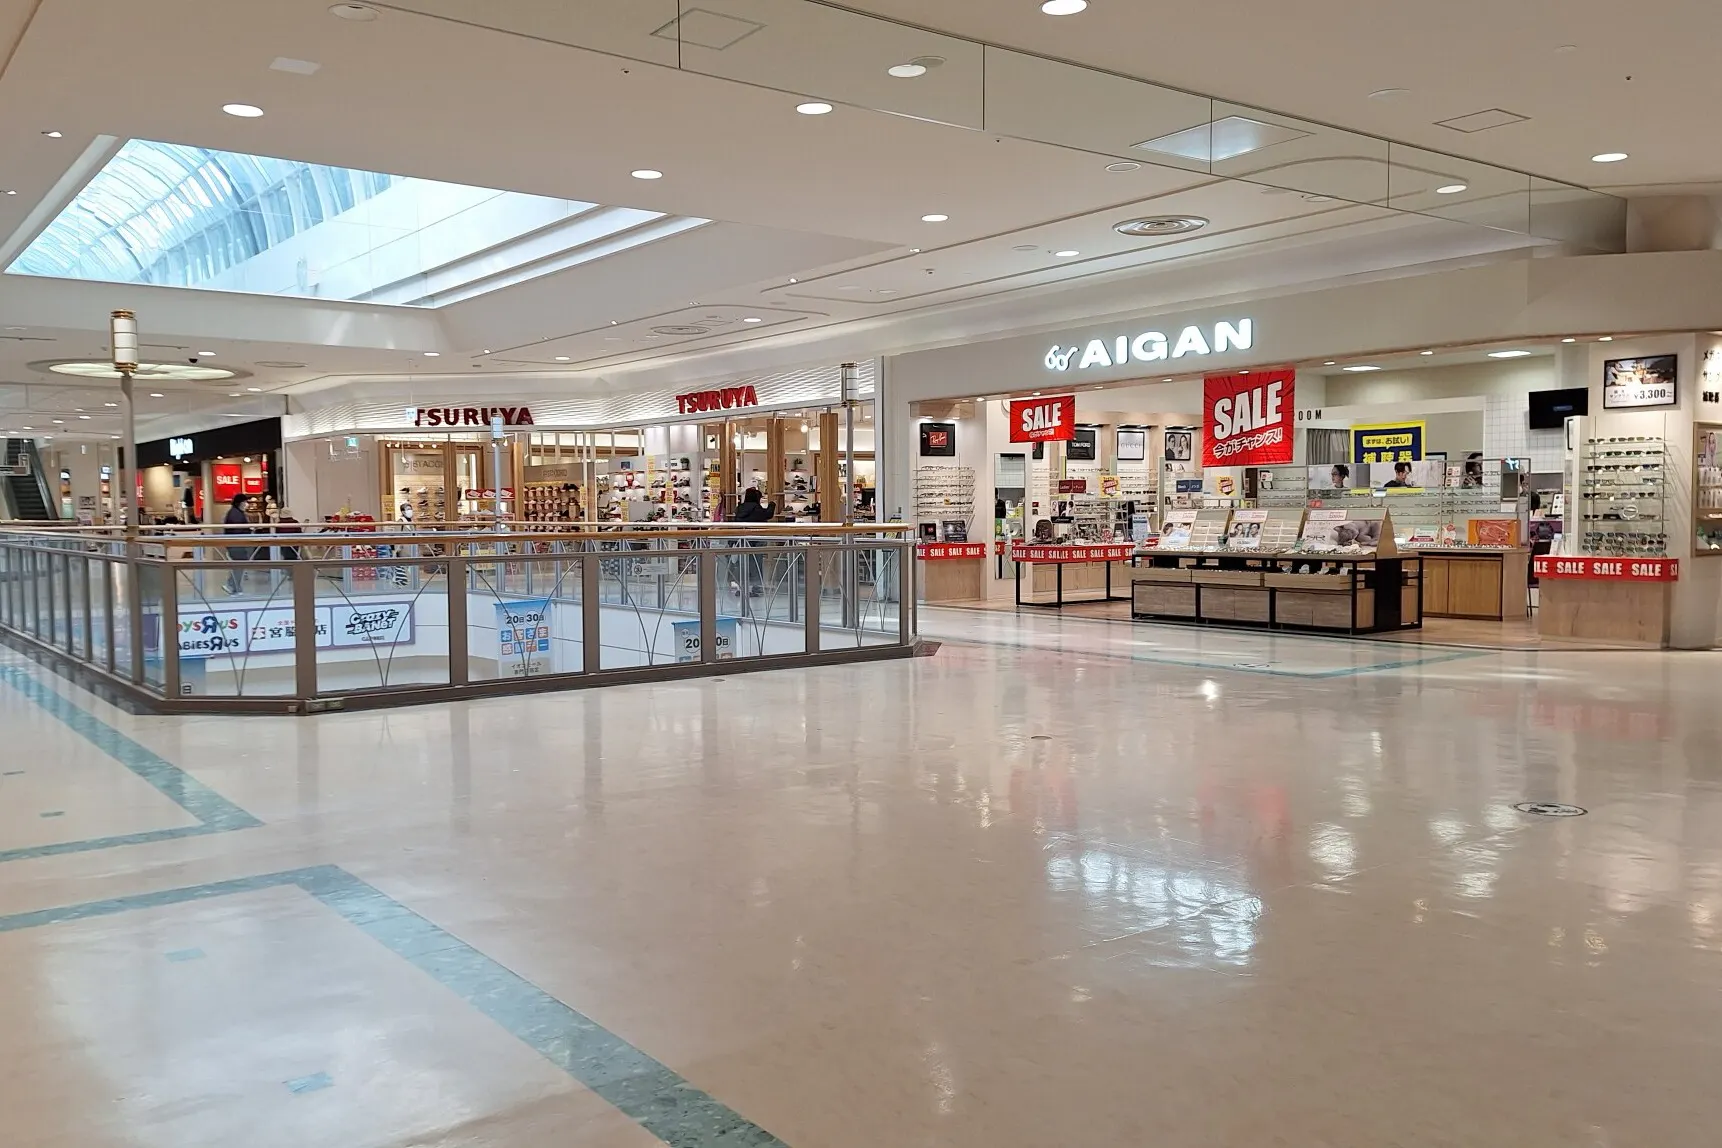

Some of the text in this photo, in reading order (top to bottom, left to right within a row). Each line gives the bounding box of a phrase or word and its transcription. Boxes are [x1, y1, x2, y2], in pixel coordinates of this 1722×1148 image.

[1079, 318, 1253, 369] AIGAN
[676, 385, 759, 414] TSURUYA
[1213, 381, 1283, 440] SALE
[1022, 402, 1062, 432] SALE
[1213, 427, 1283, 459] 今がチャンス!
[216, 475, 239, 485] SALE
[930, 548, 945, 557] SALE
[948, 548, 962, 556] SALE
[966, 547, 980, 556] SALE
[1012, 550, 1026, 558] SALE
[1030, 550, 1045, 558] SALE
[1072, 550, 1087, 559] SALE
[1090, 550, 1104, 558] SALE
[1107, 549, 1121, 557] SALE
[1556, 561, 1585, 574] SALE
[1593, 562, 1622, 575] SALE
[1631, 563, 1662, 577] SALE
